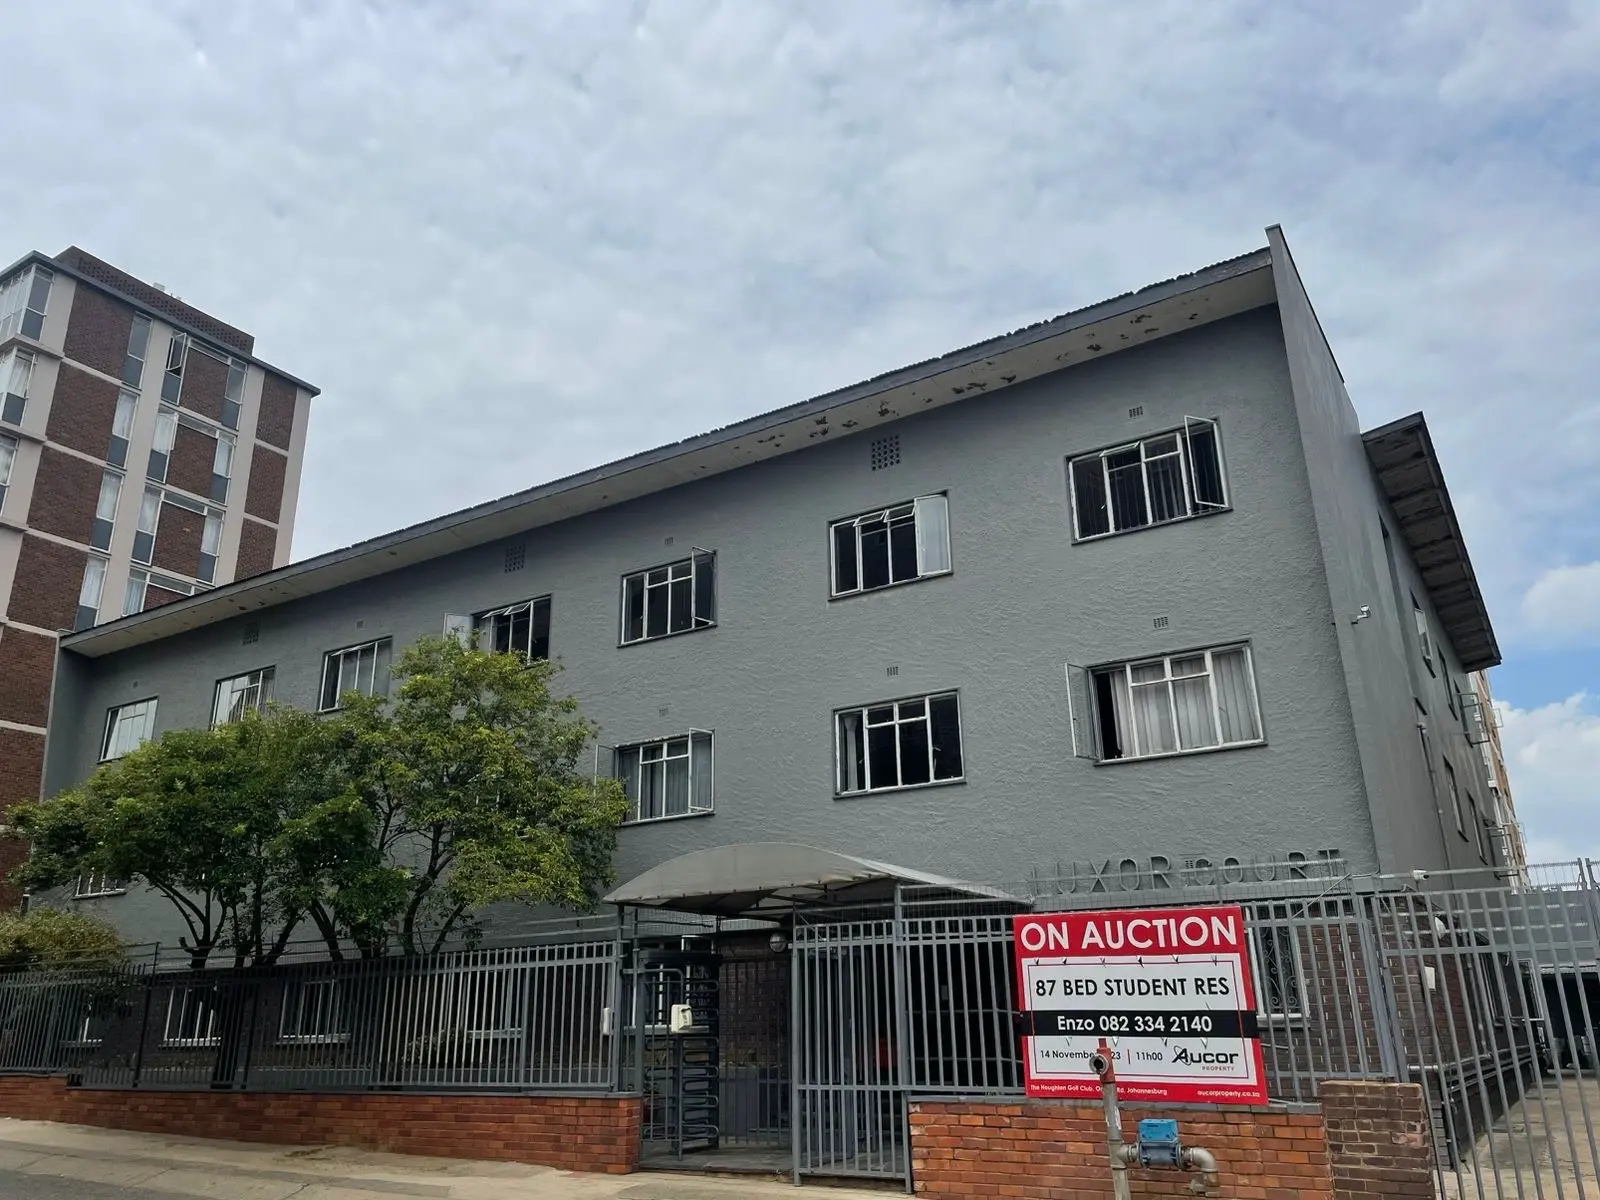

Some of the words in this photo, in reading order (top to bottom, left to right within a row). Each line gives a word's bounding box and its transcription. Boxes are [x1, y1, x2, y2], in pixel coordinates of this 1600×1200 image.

[1194, 848, 1340, 887] COURT
[1020, 922, 1070, 951] ON
[1081, 915, 1237, 950] AUCTION
[1035, 979, 1056, 997] 87
[1063, 979, 1098, 996] BED
[1104, 977, 1187, 997] STUDENT
[1194, 976, 1230, 996] RES
[1057, 1015, 1095, 1031] Enzo
[1099, 1015, 1130, 1032] 082
[1134, 1015, 1165, 1032] 334
[1169, 1015, 1213, 1032] 2140
[1040, 1049, 1051, 1059] 14
[1052, 1049, 1095, 1059] Novembe
[1136, 1051, 1163, 1061] 11h00
[1171, 1046, 1239, 1065] Aucor
[1126, 1087, 1168, 1096] Johannesburg
[1197, 1090, 1260, 1098] aucorproperty.co.za
